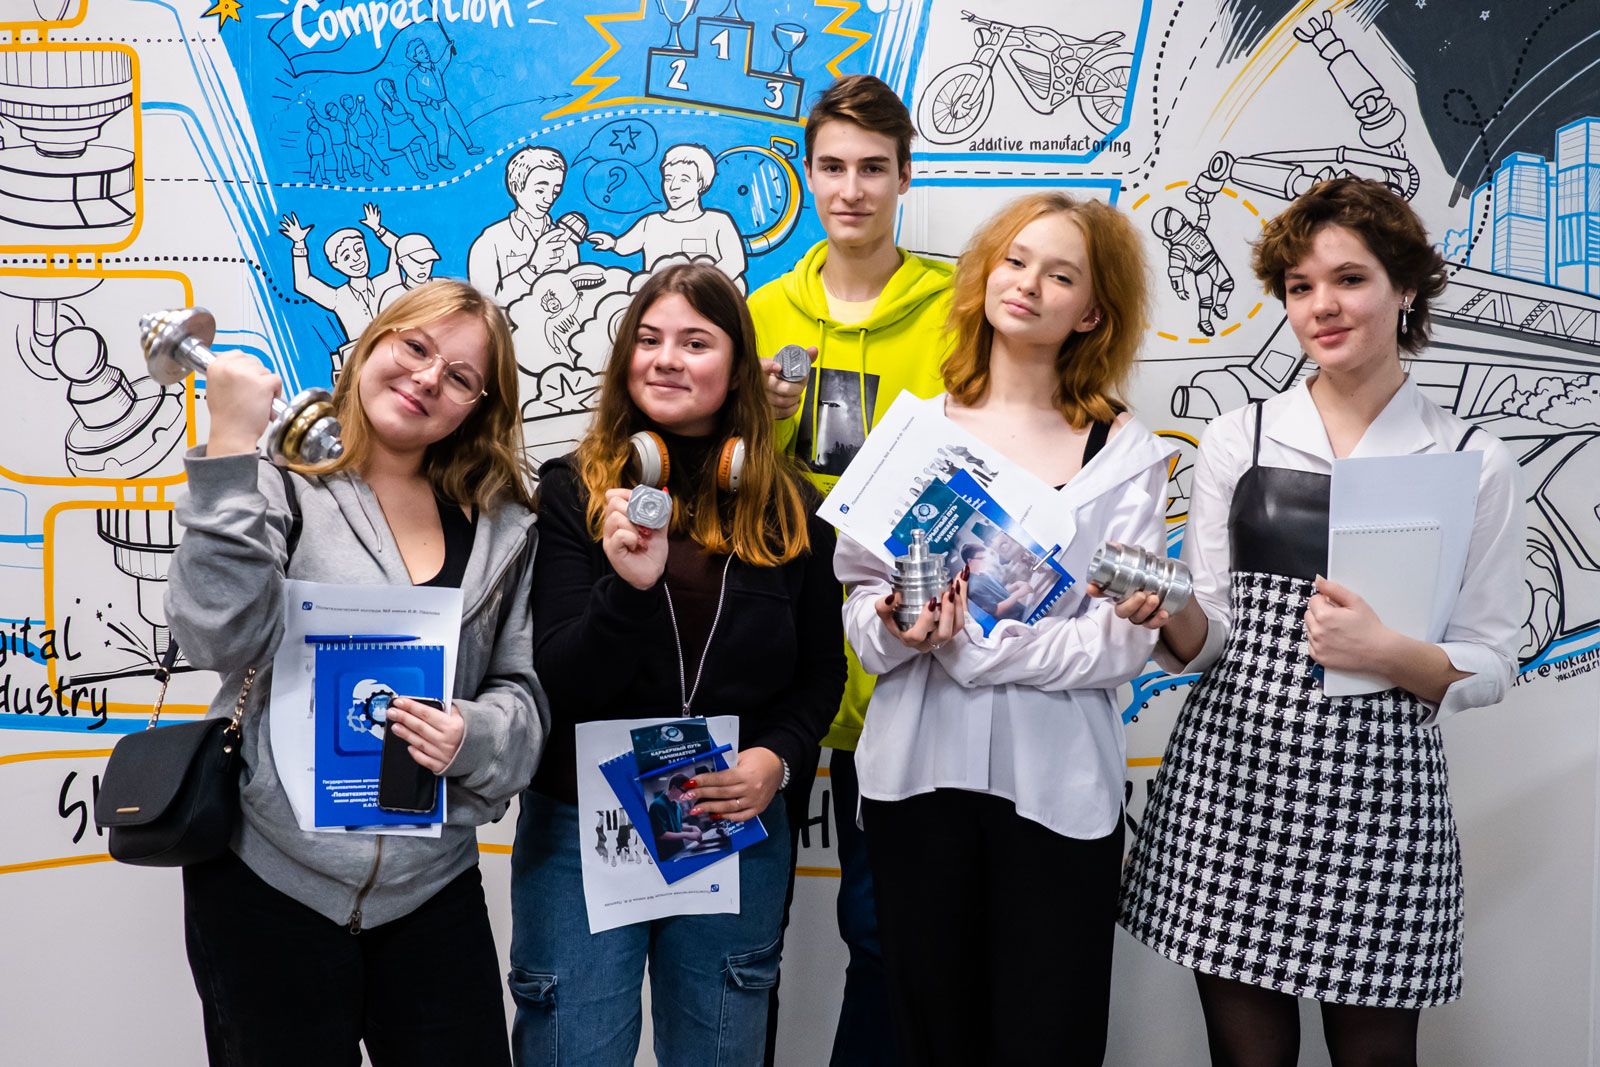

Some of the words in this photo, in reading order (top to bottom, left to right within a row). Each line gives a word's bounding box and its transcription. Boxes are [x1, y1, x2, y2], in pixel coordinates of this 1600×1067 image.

[292, 0, 514, 49] Competition
[710, 28, 730, 60] 1
[667, 59, 689, 91] 2
[763, 81, 784, 110] 3
[969, 136, 1023, 151] additive
[1029, 134, 1131, 158] manufactoring
